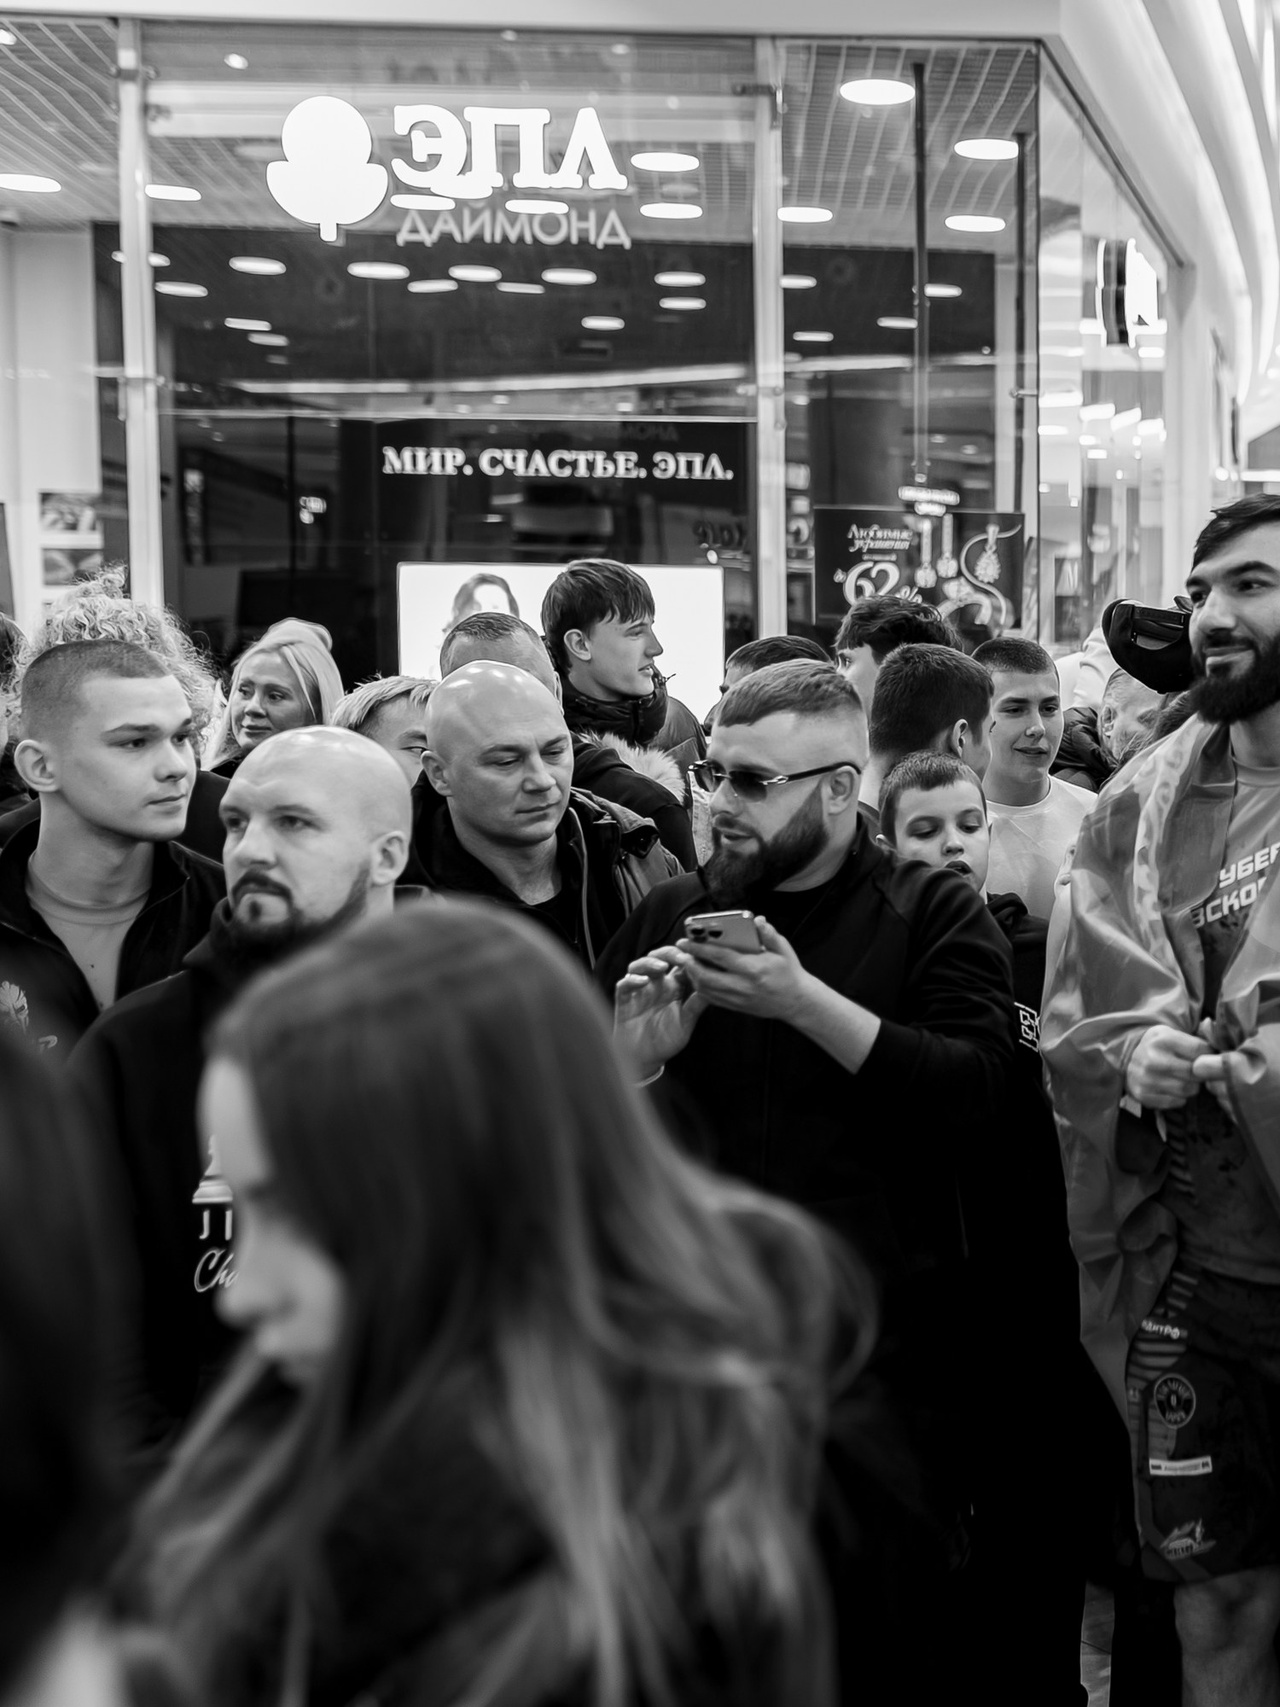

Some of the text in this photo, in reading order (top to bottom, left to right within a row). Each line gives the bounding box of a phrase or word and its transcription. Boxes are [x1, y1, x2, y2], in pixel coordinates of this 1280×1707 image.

[391, 104, 629, 189] ЭПЛ
[396, 201, 632, 250] ДАЙМОНД
[382, 446, 734, 481] МИР. СЧАСТЬЕ. ЭПЛ.
